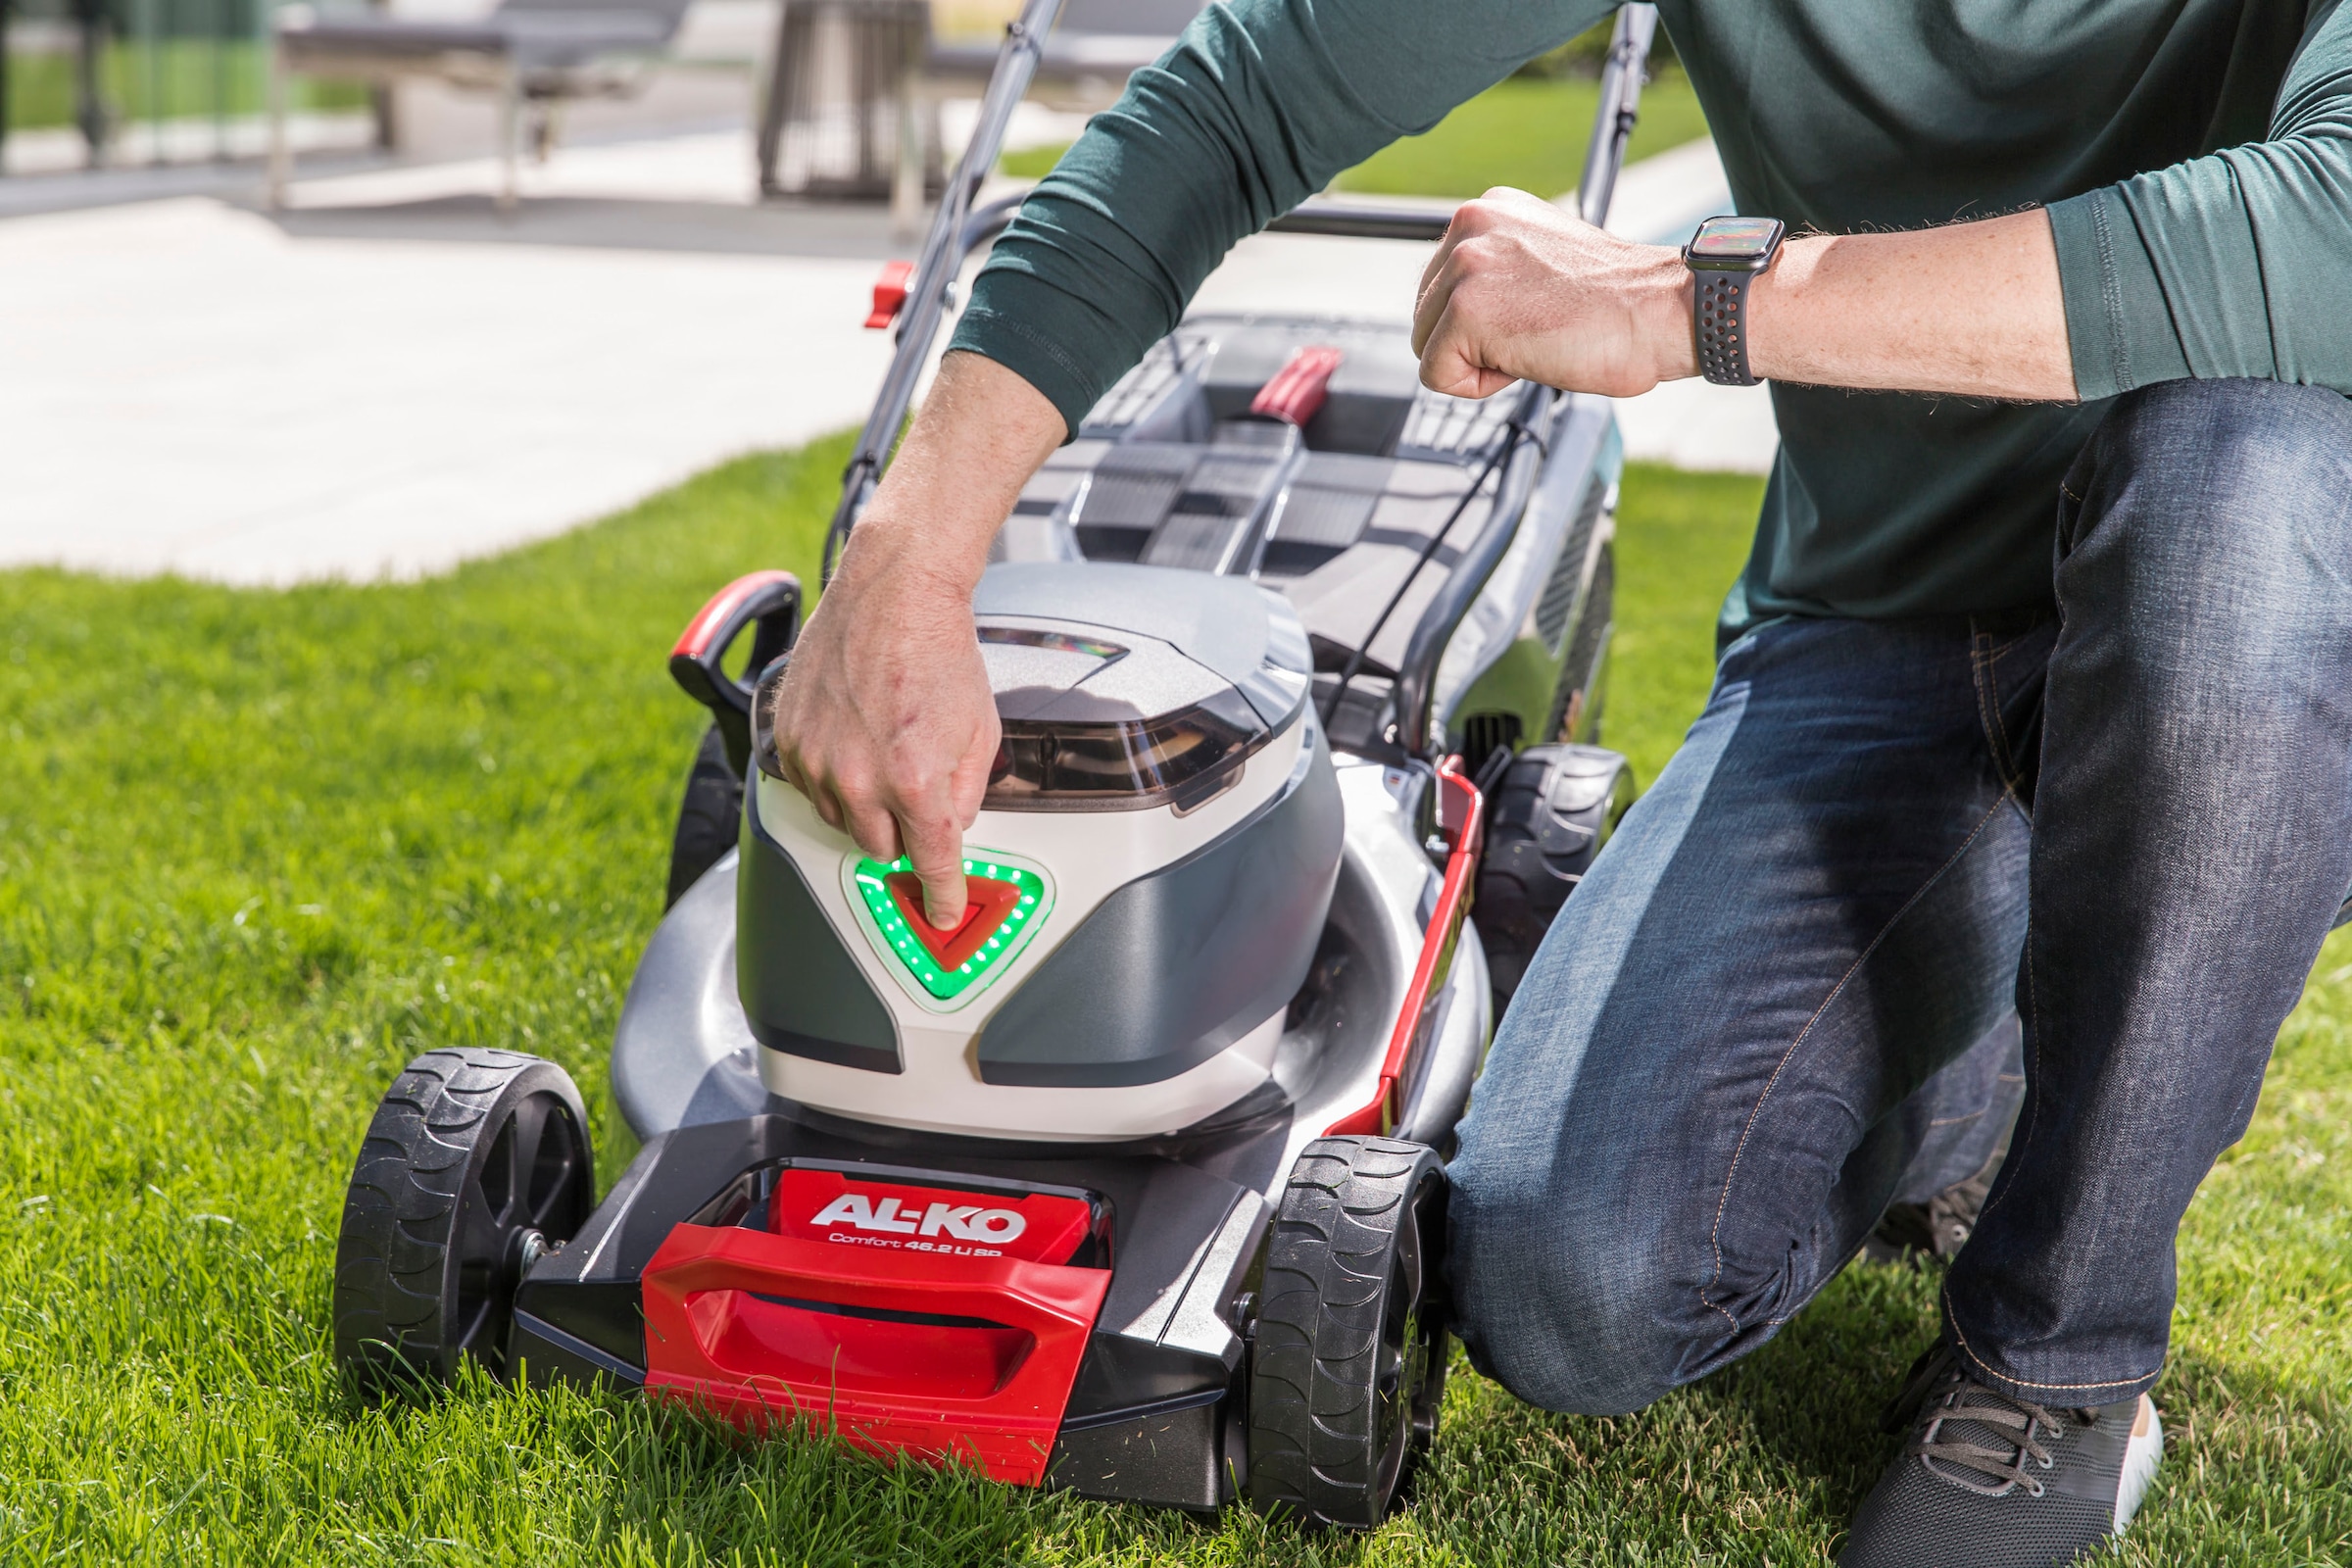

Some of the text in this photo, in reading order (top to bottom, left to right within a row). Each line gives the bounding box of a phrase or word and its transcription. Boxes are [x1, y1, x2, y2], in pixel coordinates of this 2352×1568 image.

[809, 1194, 1026, 1244] AL-KO
[829, 1233, 902, 1248] Comfort
[905, 1241, 953, 1253] 46.2
[955, 1246, 972, 1255] Li
